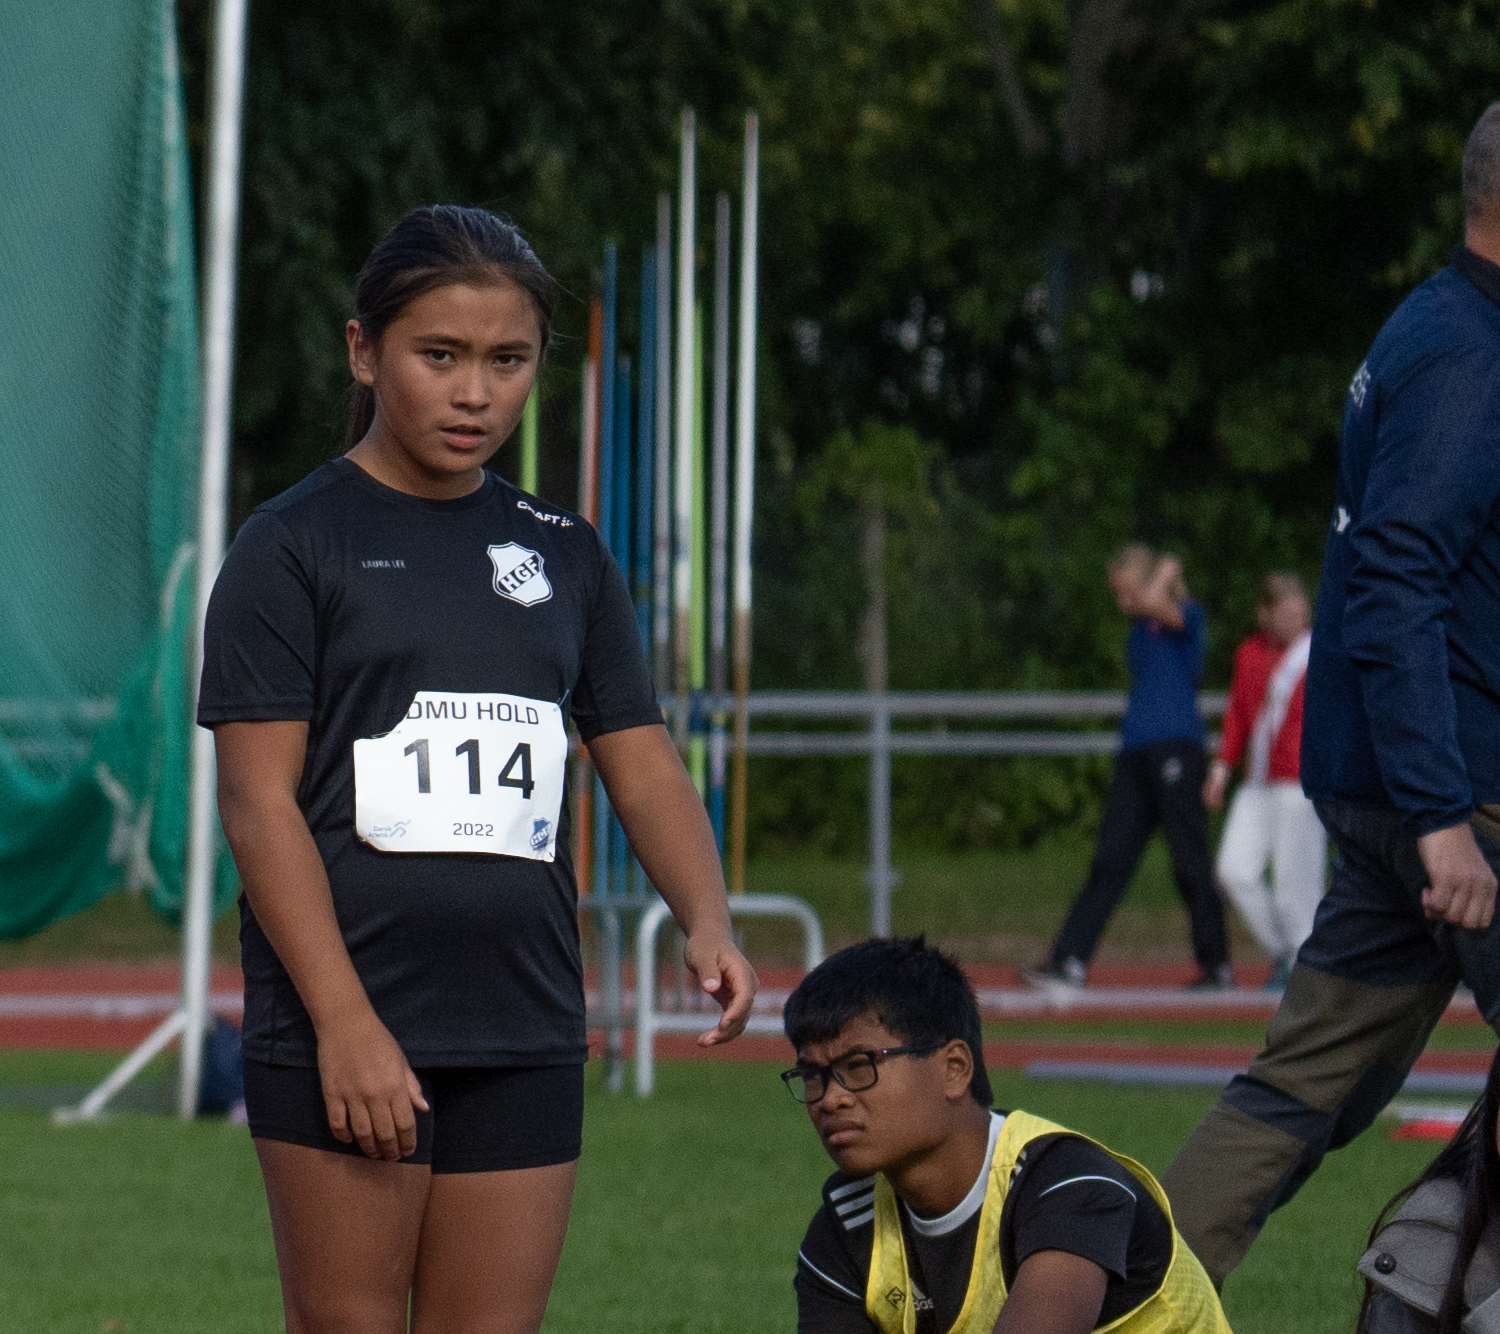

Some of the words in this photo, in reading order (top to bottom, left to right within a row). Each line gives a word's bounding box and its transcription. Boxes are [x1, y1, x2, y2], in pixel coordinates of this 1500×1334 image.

[516, 500, 561, 524] CAFT
[499, 558, 539, 594] HGF
[406, 700, 468, 720] DMU
[477, 701, 540, 726] HOLD
[403, 738, 536, 800] 114
[453, 822, 495, 837] 2022
